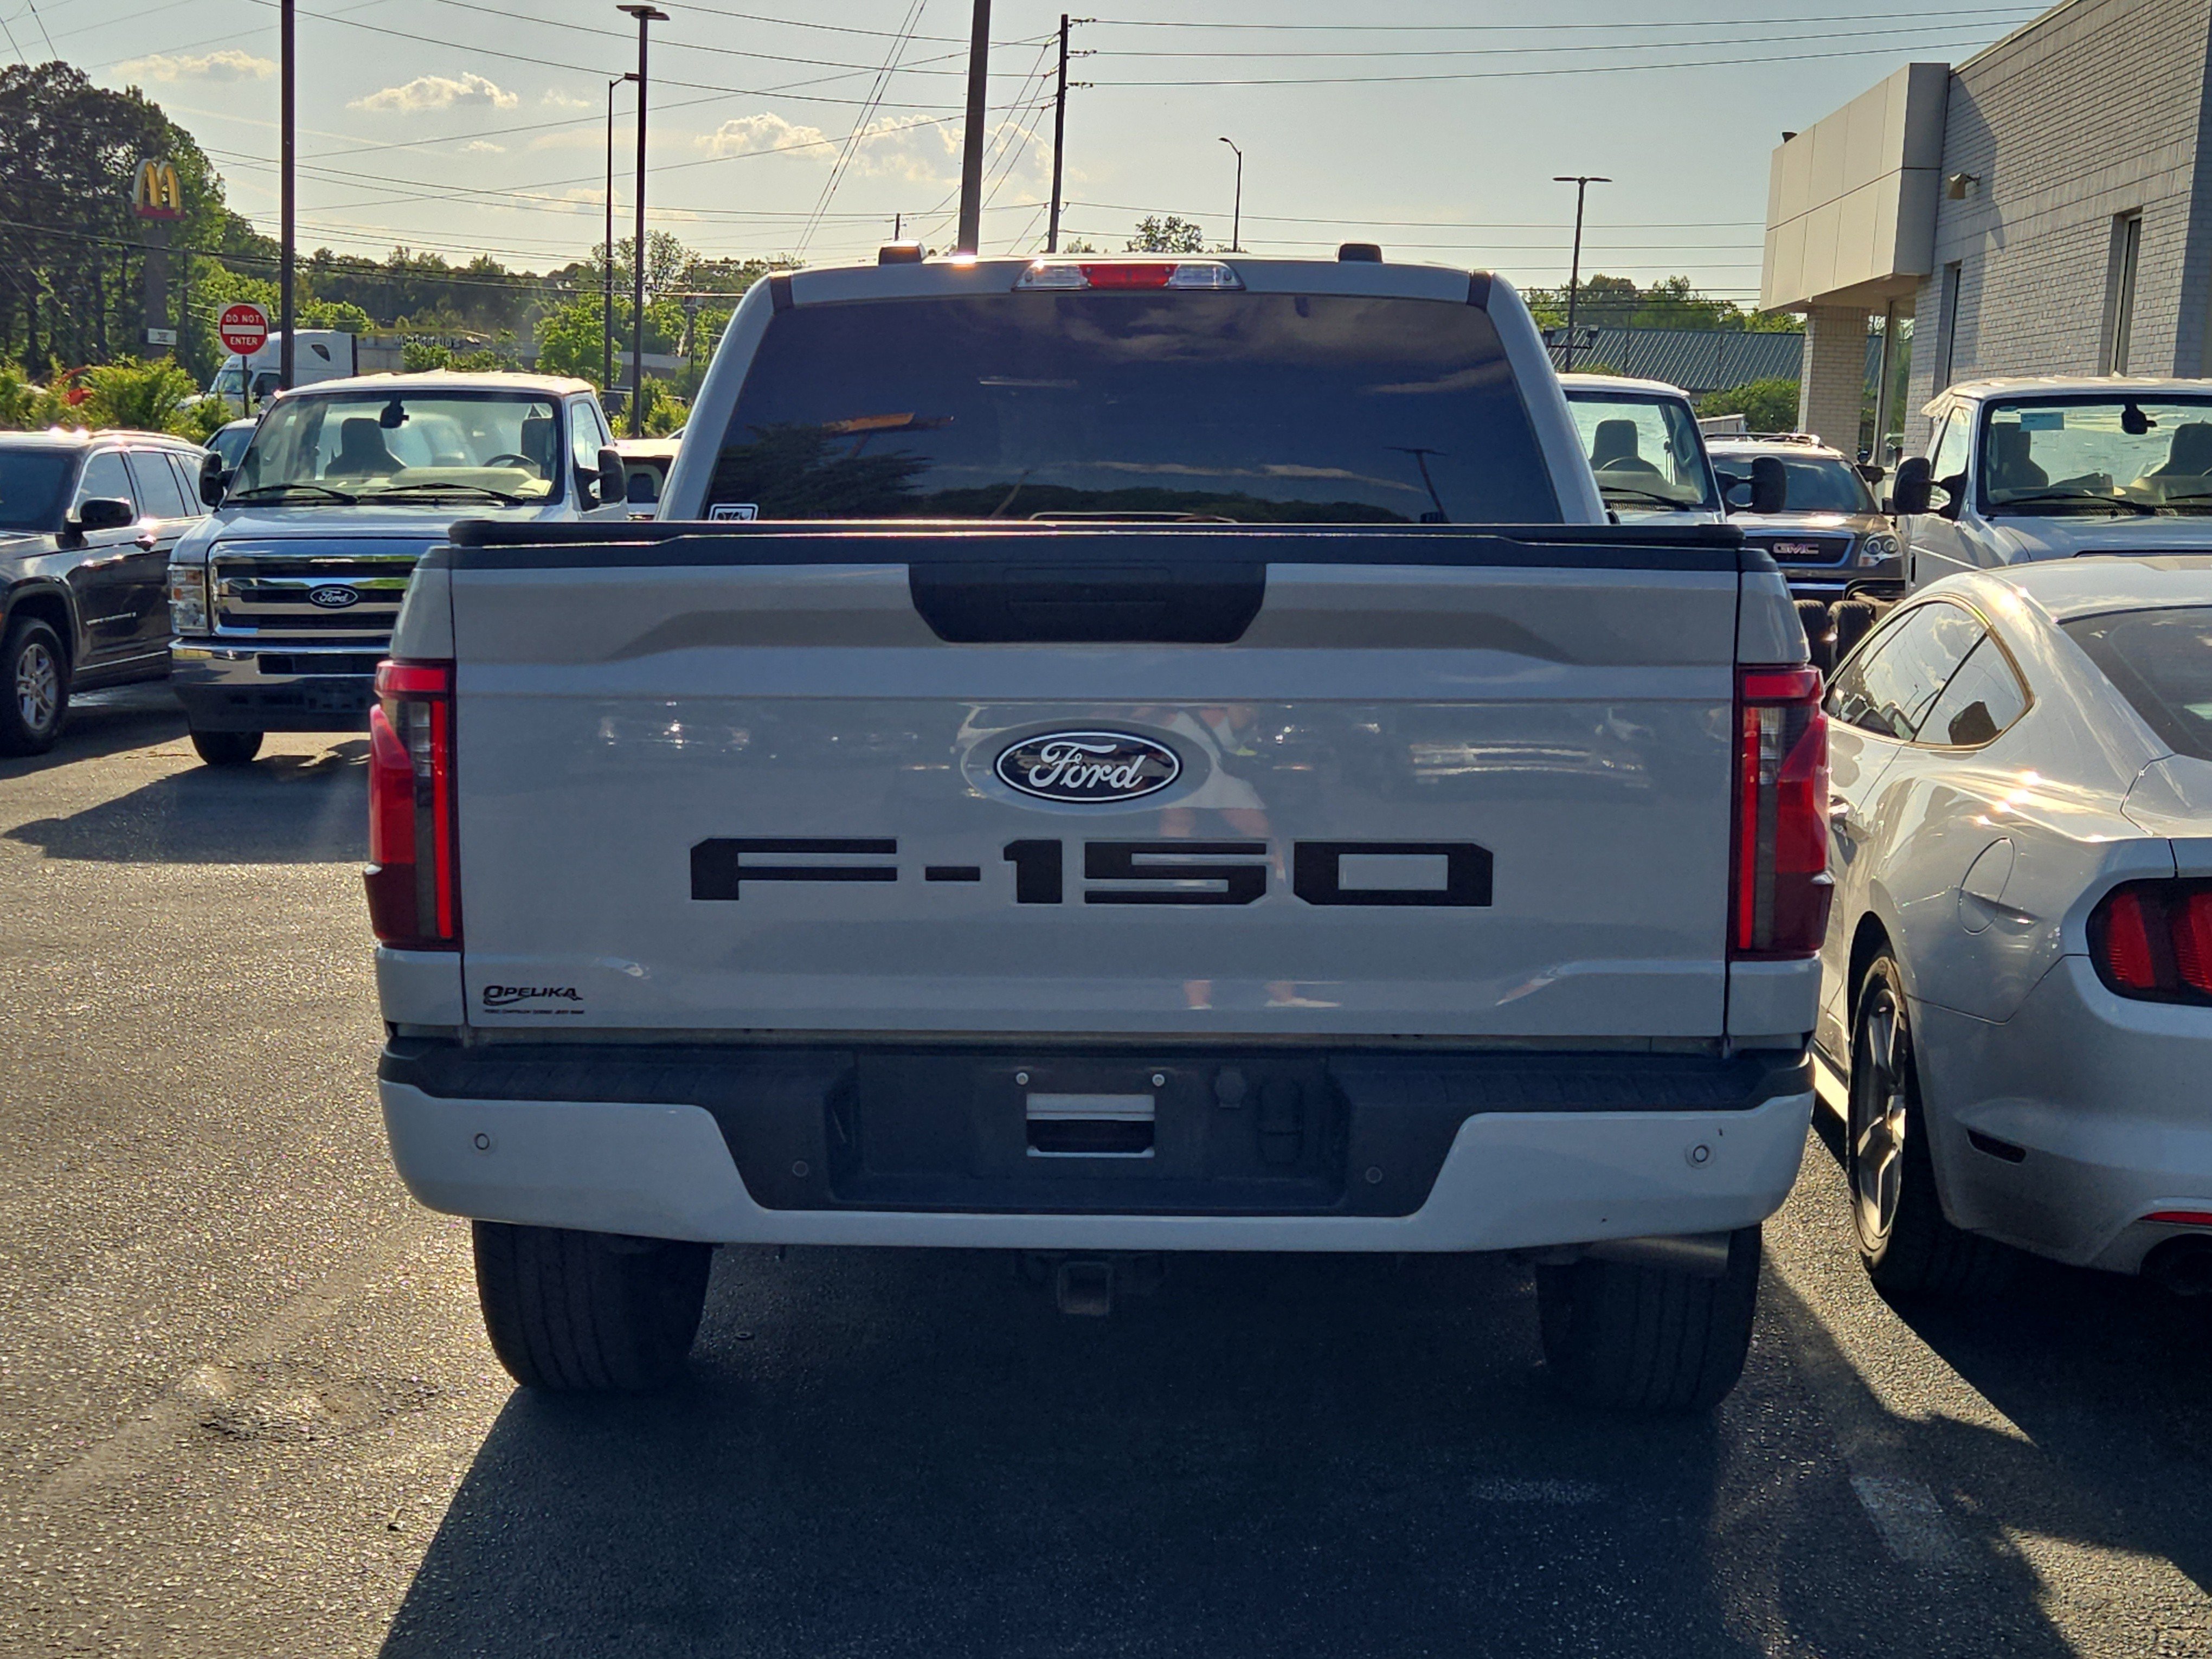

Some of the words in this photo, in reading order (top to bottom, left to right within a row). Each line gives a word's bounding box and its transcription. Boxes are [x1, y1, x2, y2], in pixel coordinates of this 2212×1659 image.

[226, 314, 238, 323] DO
[242, 315, 260, 323] NOT
[230, 337, 258, 345] ENTER
[1773, 543, 1819, 554] GMC
[319, 588, 348, 602] Ford
[1029, 742, 1147, 788] Ford
[690, 838, 1493, 906] F-150
[484, 985, 582, 1002] OPELIKA
